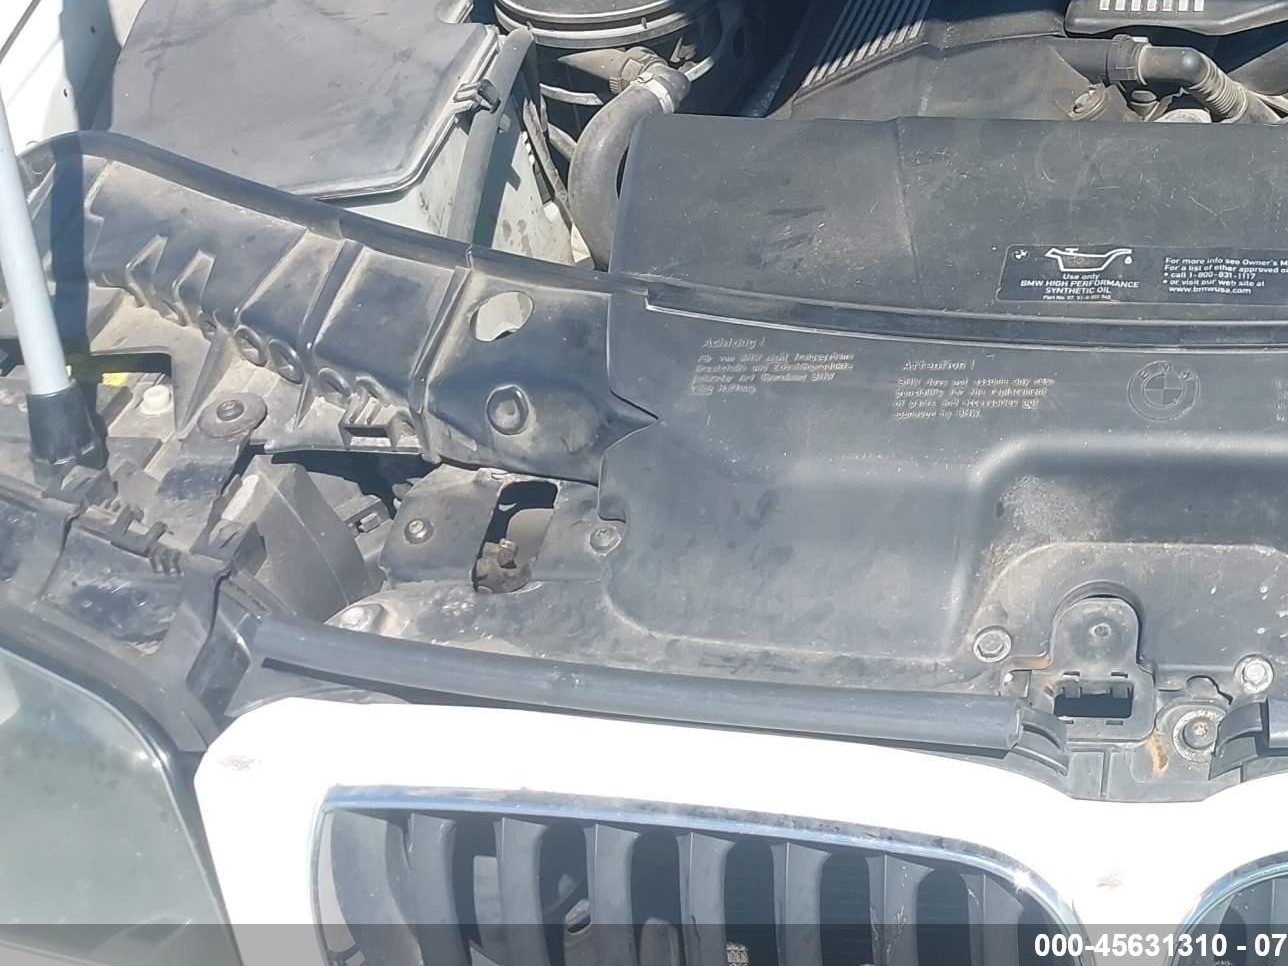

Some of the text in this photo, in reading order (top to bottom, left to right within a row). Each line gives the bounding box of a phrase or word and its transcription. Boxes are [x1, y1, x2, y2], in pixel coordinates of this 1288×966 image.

[1214, 264, 1237, 272] other
[1081, 273, 1101, 281] only
[1189, 272, 1256, 280] 1-800-831-1117
[1070, 279, 1140, 288] PERFORMANCE
[1168, 286, 1252, 294] www.bmwusa.com
[904, 360, 966, 371] Attention
